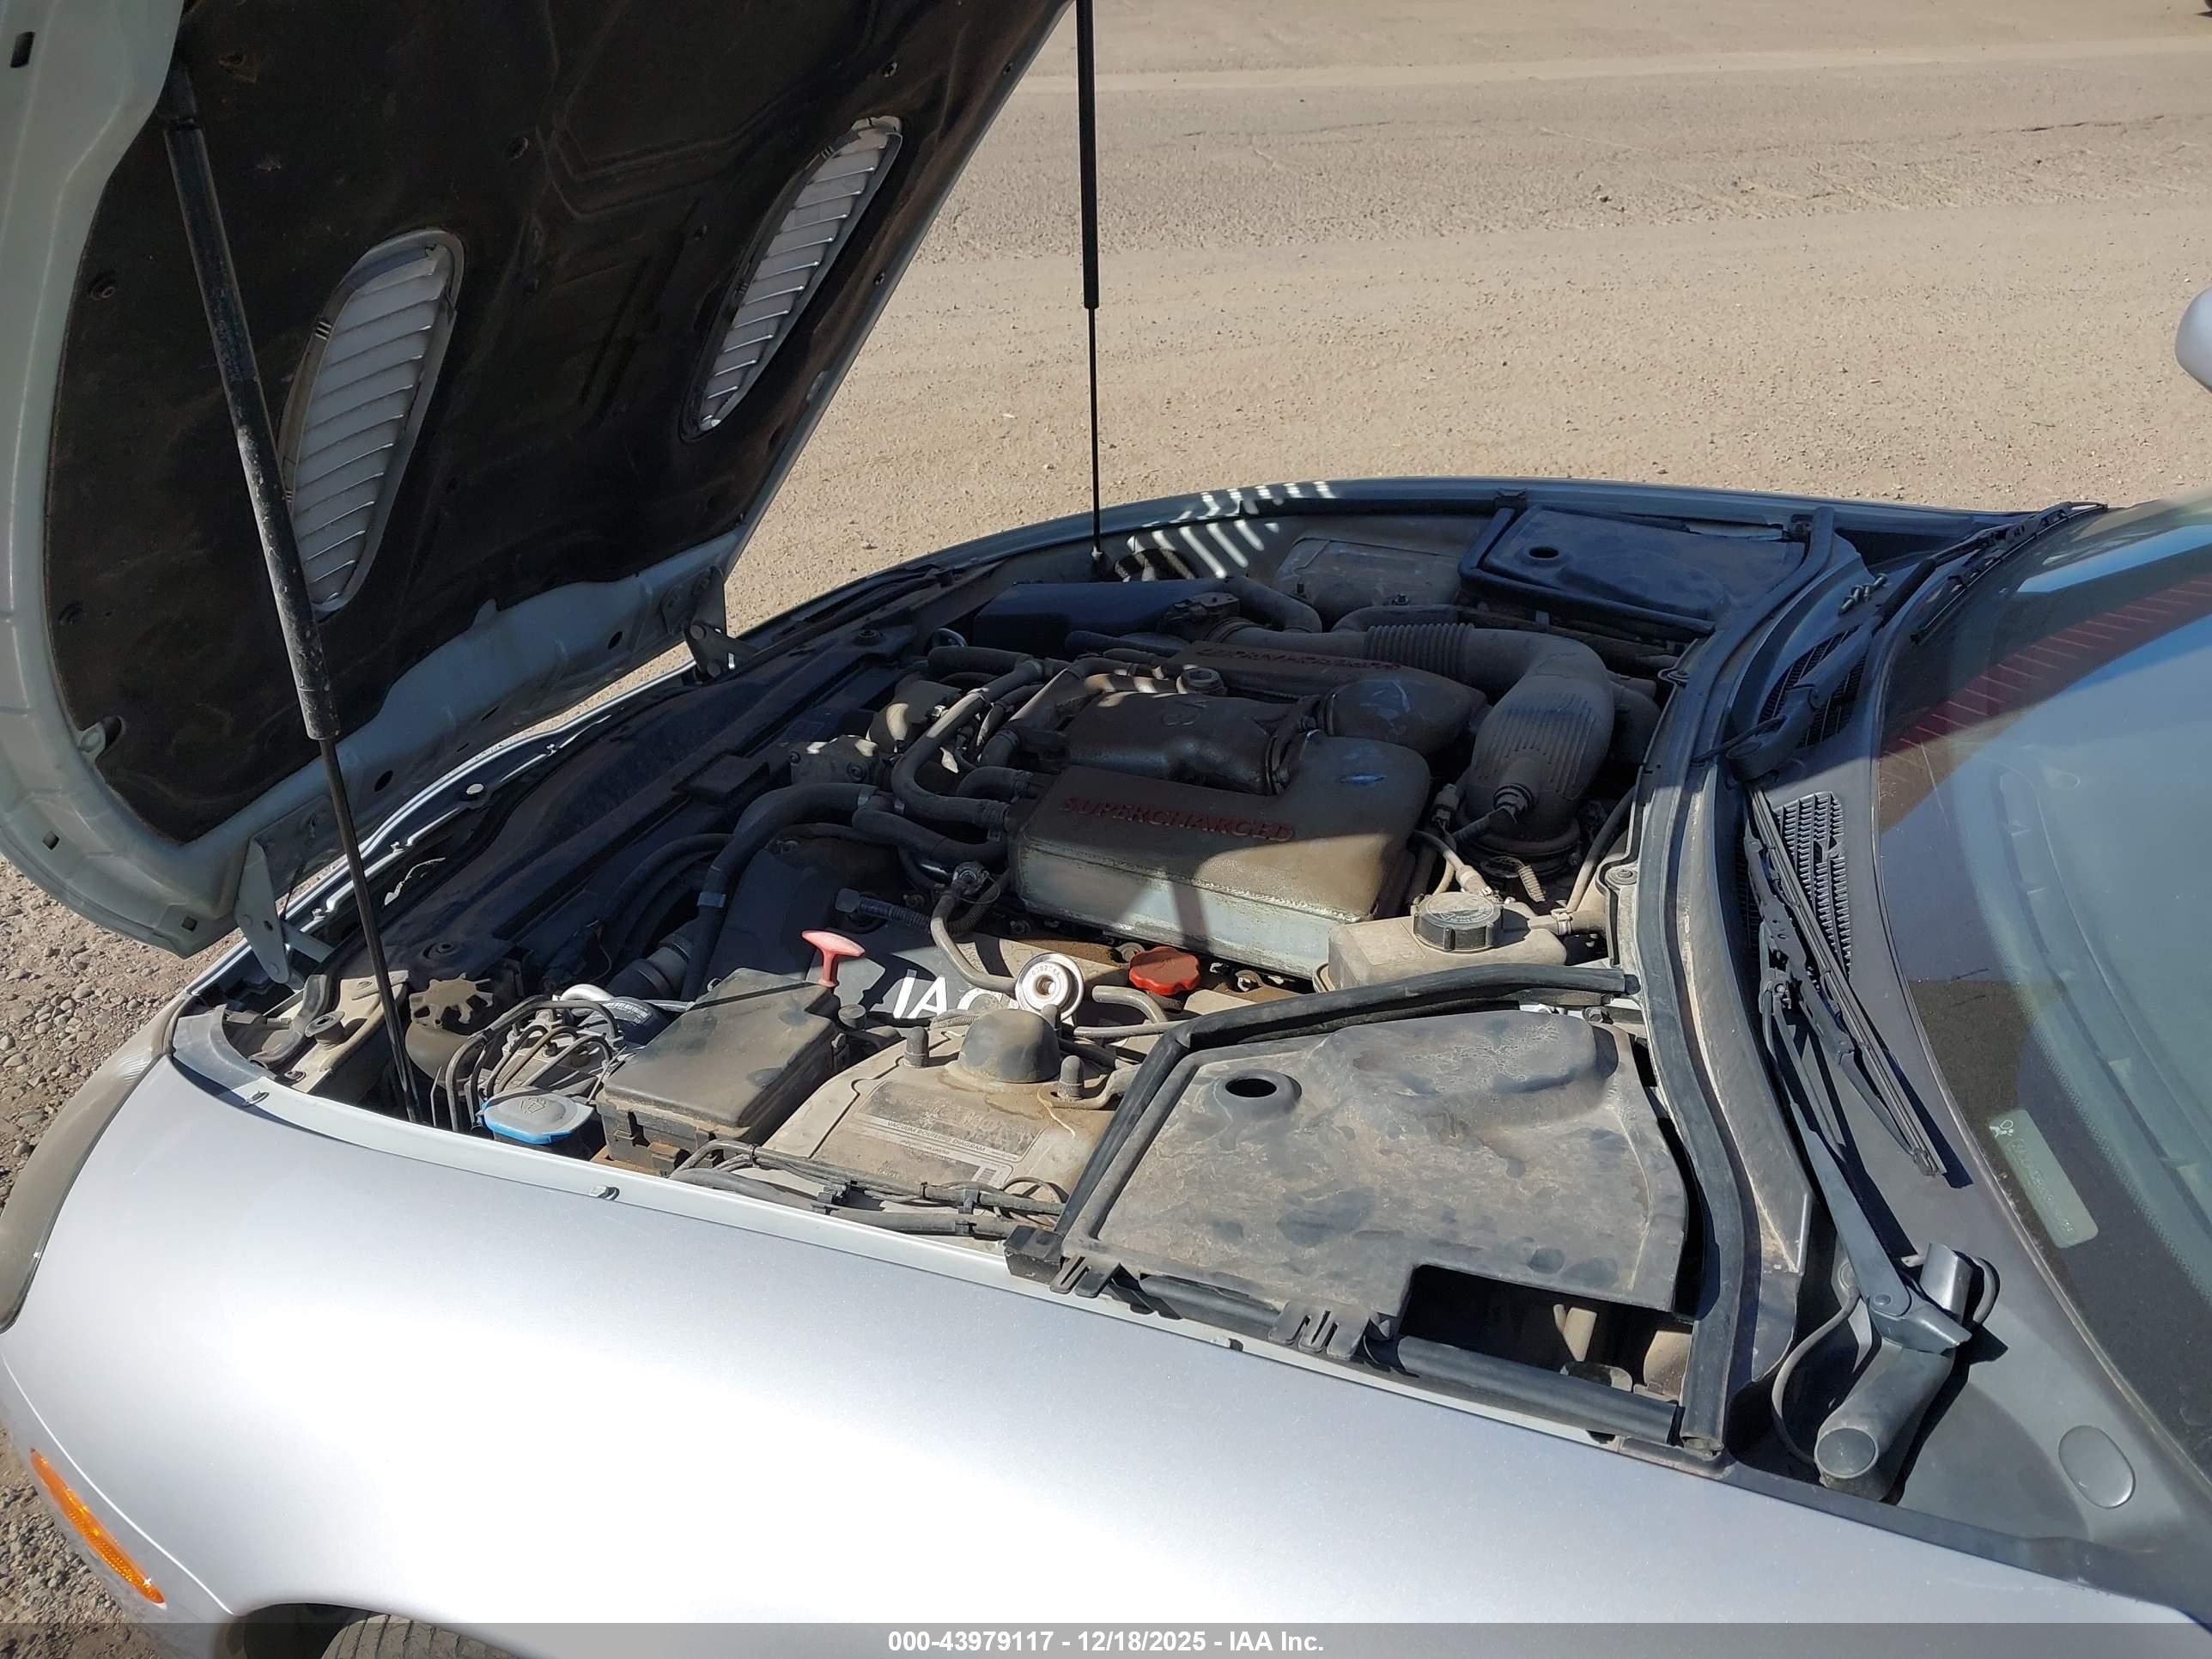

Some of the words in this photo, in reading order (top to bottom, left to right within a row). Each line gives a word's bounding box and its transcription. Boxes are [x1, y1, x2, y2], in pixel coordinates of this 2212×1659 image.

[1061, 797, 1296, 842] SUPERCHARGED
[887, 1121, 917, 1133] VACUUM
[952, 1139, 987, 1153] DIAGRAM
